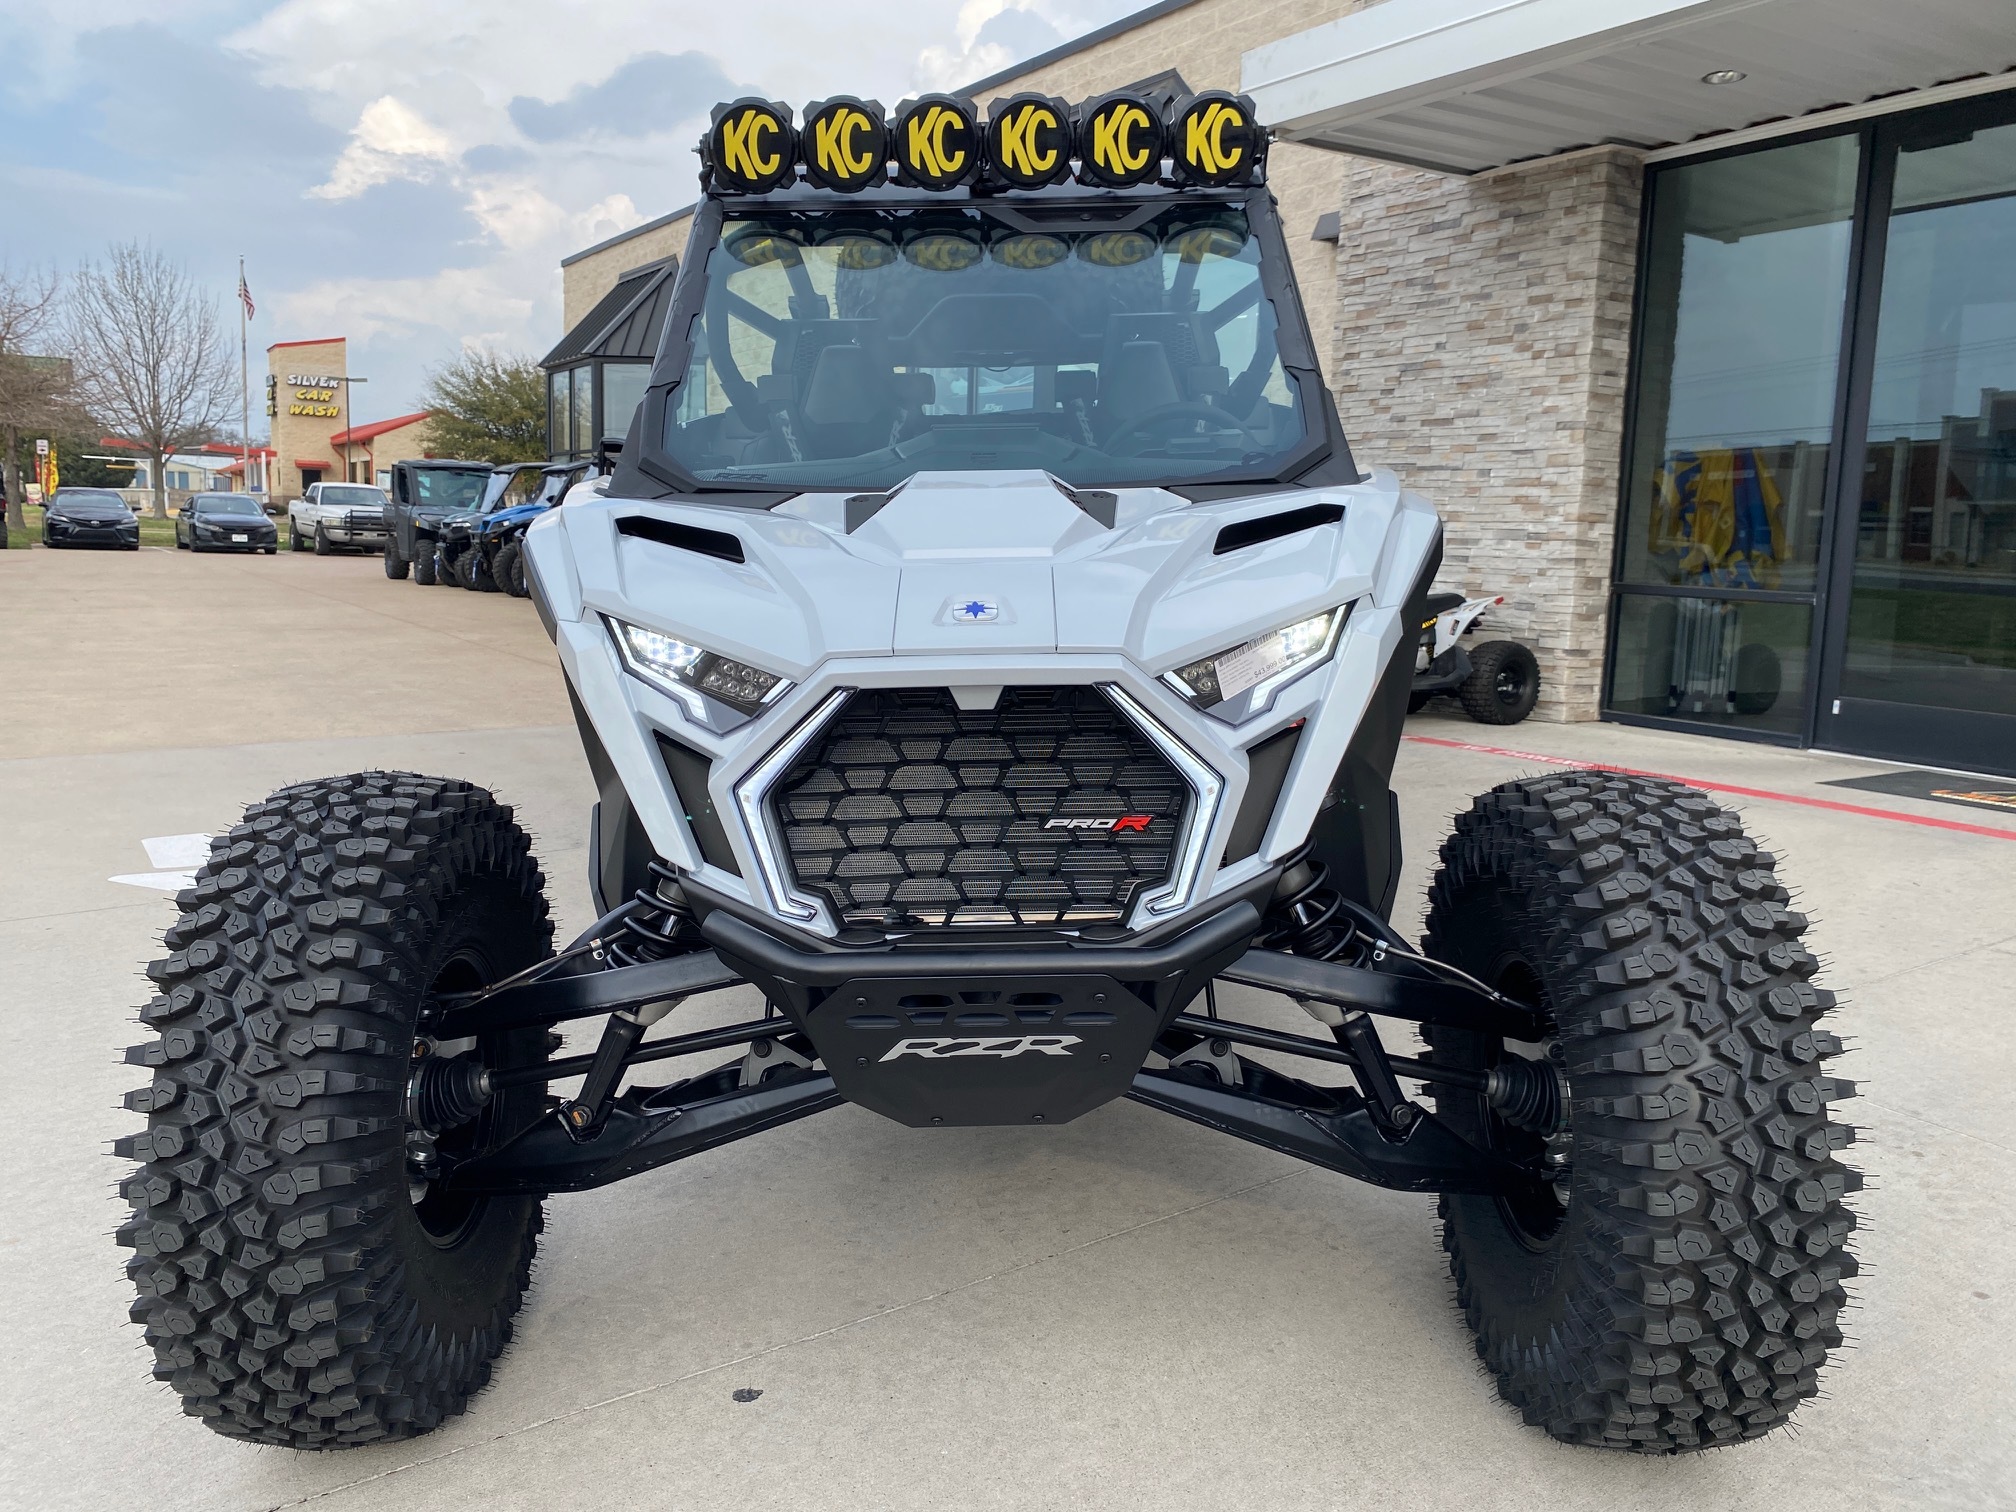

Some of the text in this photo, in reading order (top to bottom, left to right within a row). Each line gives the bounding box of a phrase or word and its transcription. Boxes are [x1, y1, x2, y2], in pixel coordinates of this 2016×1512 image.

[723, 110, 781, 180] KC
[815, 108, 873, 178] KC
[908, 106, 965, 177] KC
[1001, 105, 1057, 175] KC
[1094, 104, 1150, 175] KC
[1186, 103, 1243, 173] KC
[287, 374, 340, 389] SILVER
[289, 404, 340, 417] WASH
[295, 388, 333, 402] CAR
[877, 1035, 1084, 1063] RZR
